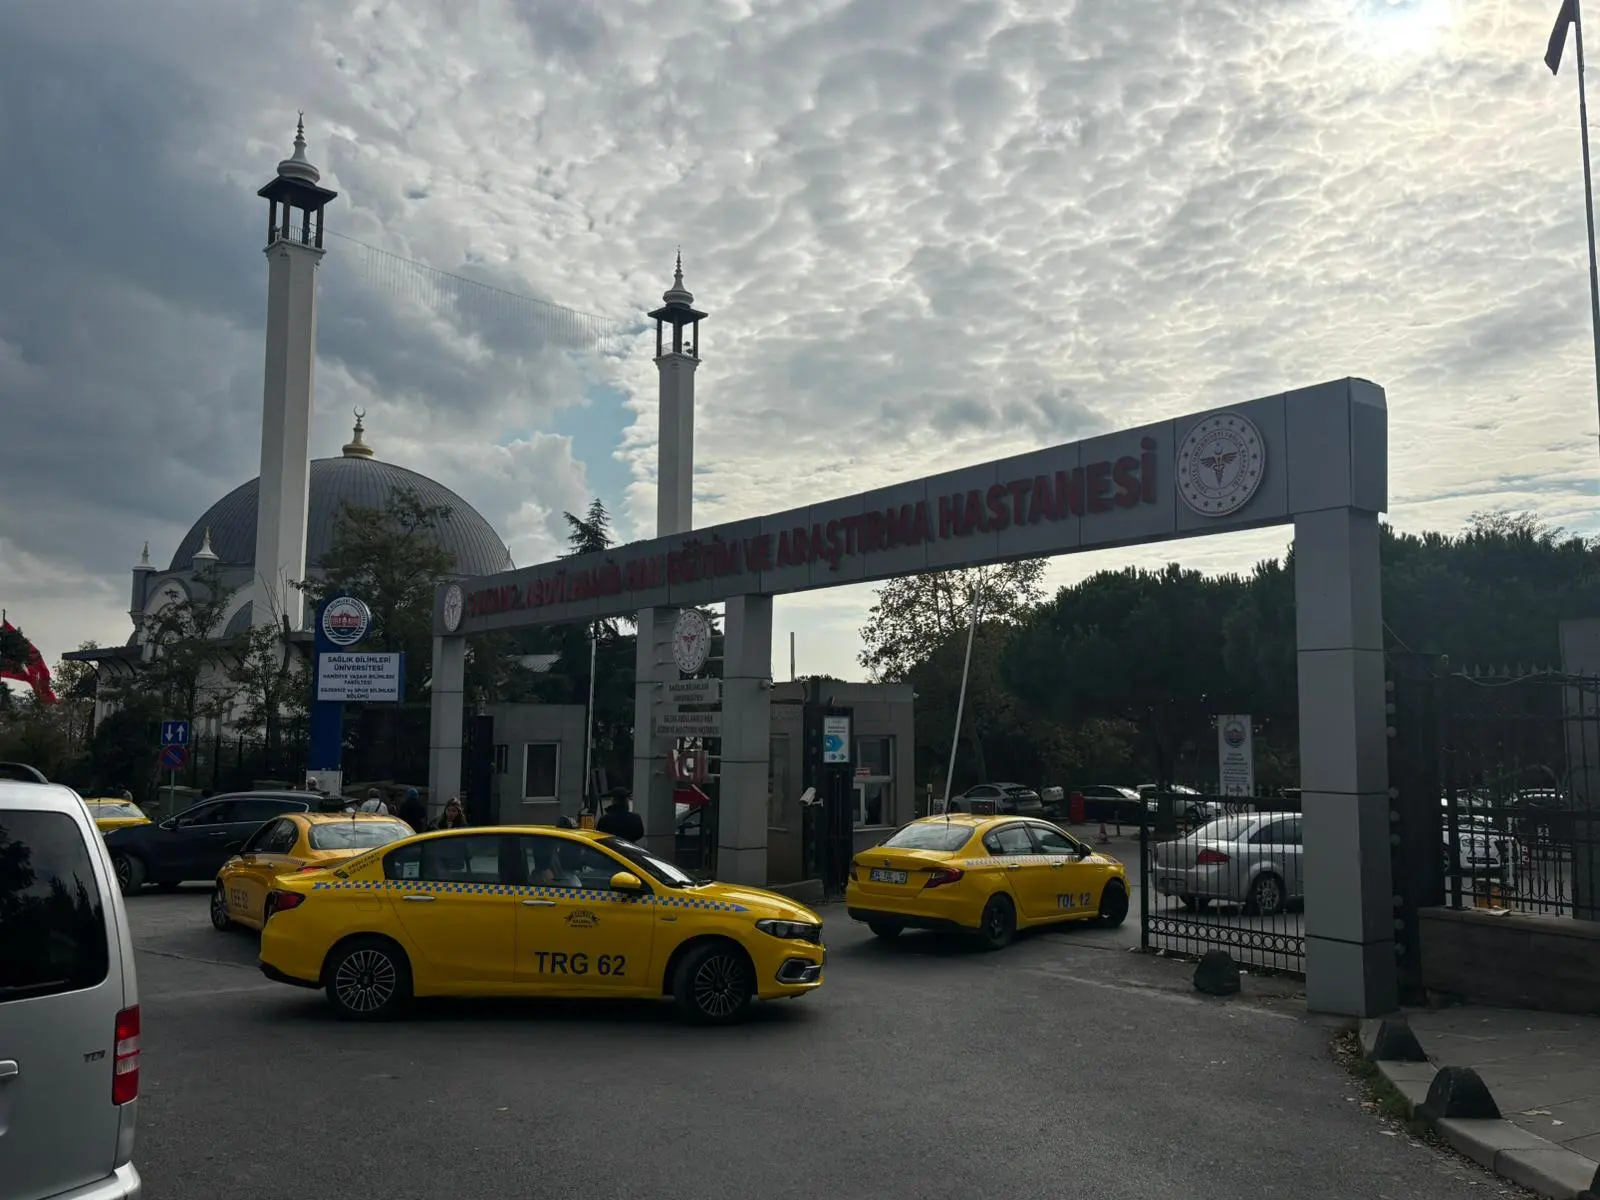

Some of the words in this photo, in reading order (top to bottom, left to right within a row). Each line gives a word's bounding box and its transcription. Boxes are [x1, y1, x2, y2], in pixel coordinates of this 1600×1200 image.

[776, 500, 935, 571] ARAŞTIRMA
[938, 436, 1158, 540] HASTANESİ
[535, 951, 589, 974] TRG
[597, 953, 626, 976] 62
